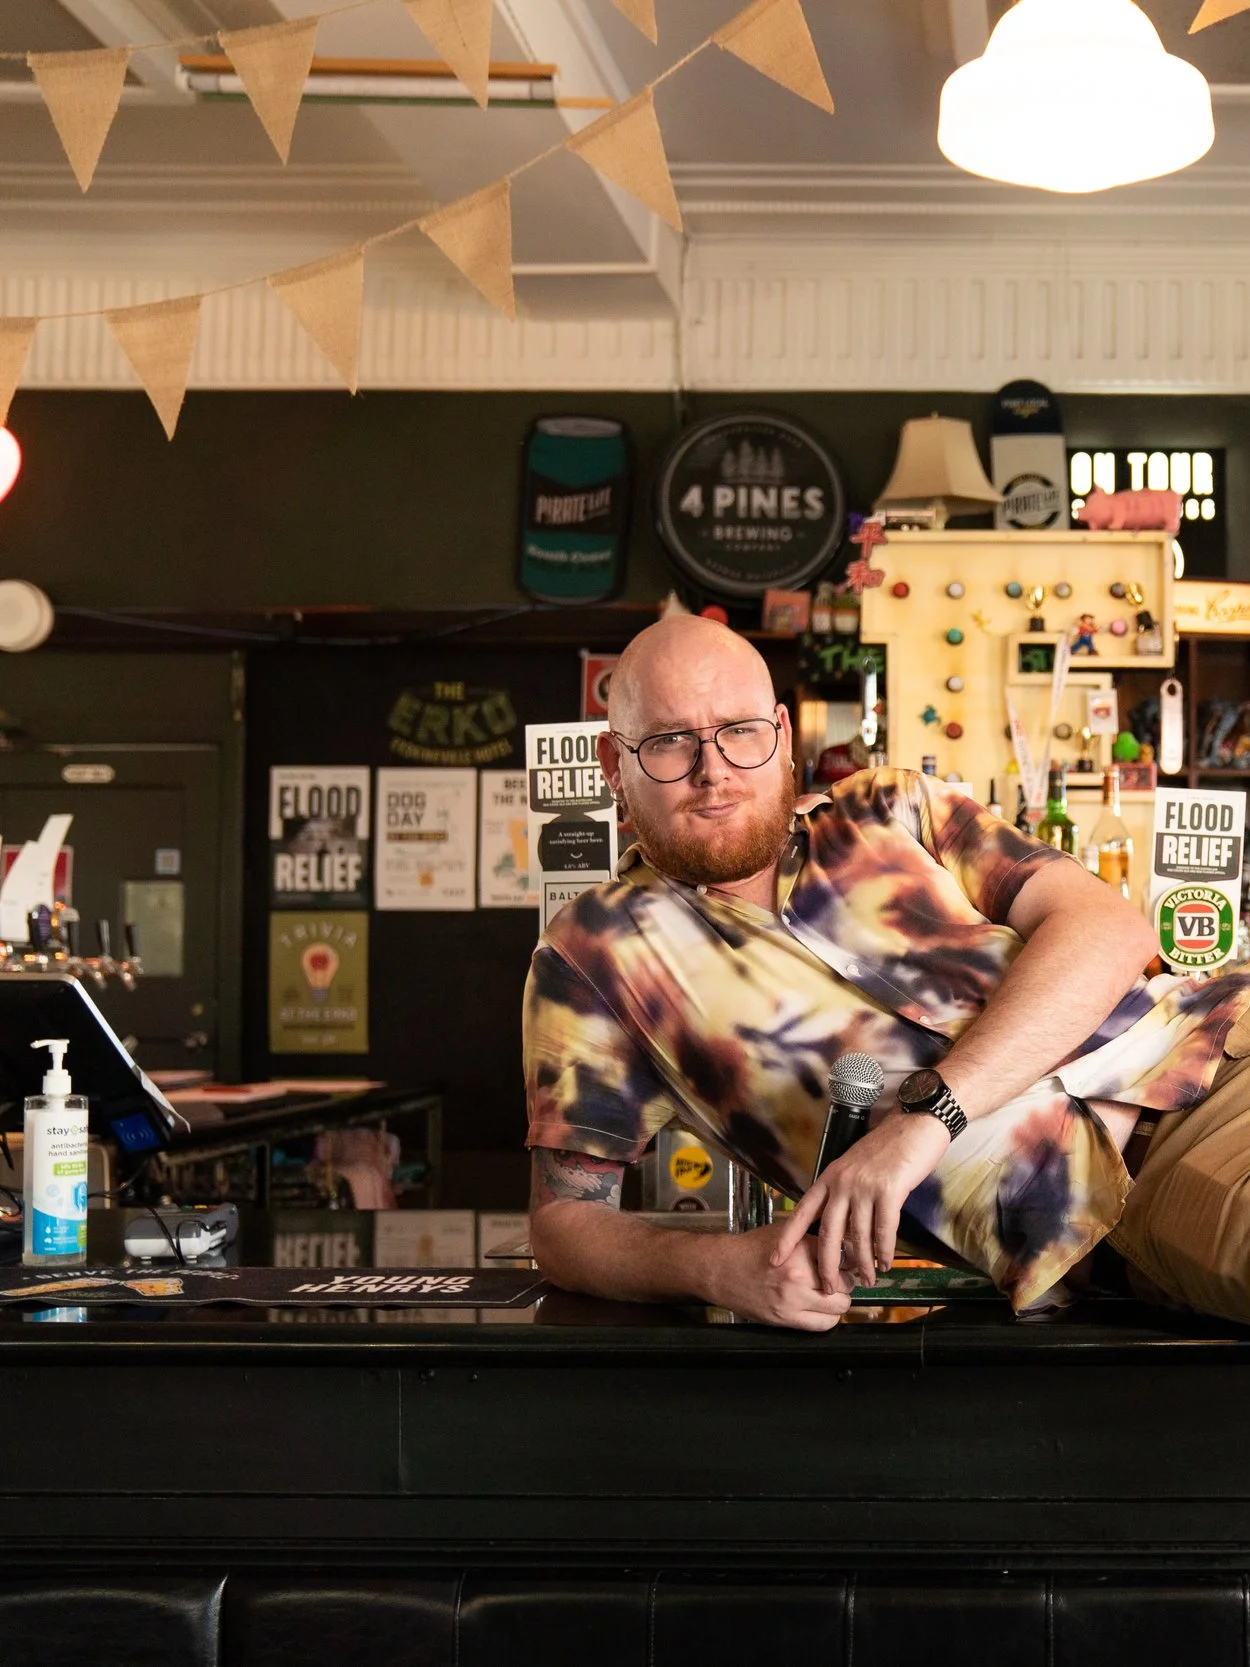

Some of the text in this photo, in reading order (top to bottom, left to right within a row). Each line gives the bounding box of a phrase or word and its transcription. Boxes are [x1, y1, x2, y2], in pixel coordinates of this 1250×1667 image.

[1127, 452, 1214, 495] TOUR
[680, 485, 825, 520] 4 PINES
[712, 525, 794, 542] BREWING
[434, 681, 464, 700] THE
[388, 690, 517, 745] ERKO
[537, 767, 606, 800] RELIEF
[279, 784, 362, 820] FLOOD
[387, 791, 426, 810] DOG
[387, 812, 424, 827] DAY
[1165, 801, 1234, 832] FLOOD
[1162, 834, 1233, 868] RELIEF
[274, 853, 362, 892] RELIEF
[1163, 889, 1228, 912] VICTORIA
[280, 920, 357, 949] TRIVIA
[1177, 916, 1216, 937] VB
[1169, 946, 1226, 965] BITTER
[46, 1126, 70, 1136] stay
[289, 1283, 472, 1294] HENRYS
[330, 1275, 475, 1285] YOUNG
